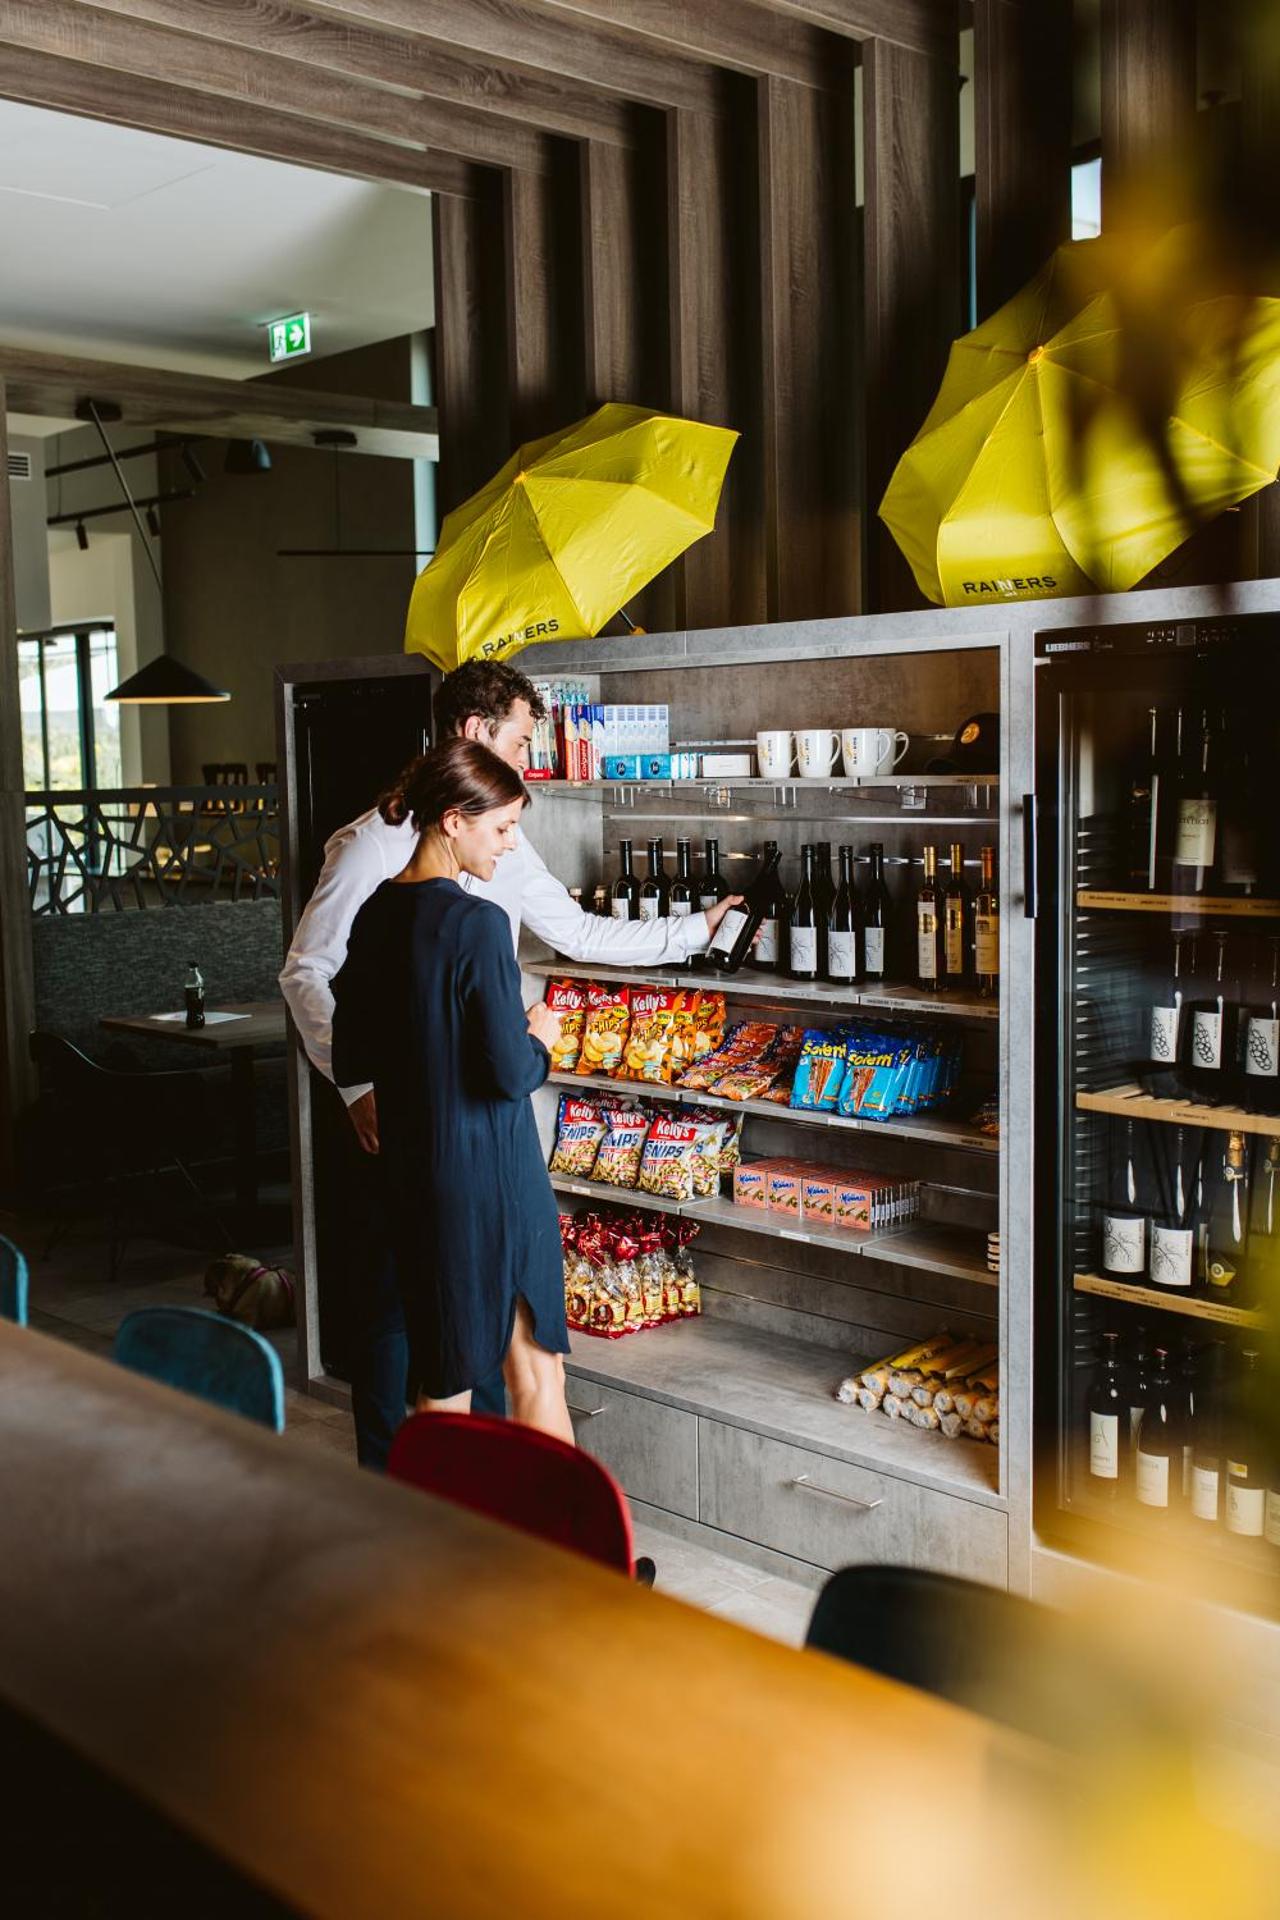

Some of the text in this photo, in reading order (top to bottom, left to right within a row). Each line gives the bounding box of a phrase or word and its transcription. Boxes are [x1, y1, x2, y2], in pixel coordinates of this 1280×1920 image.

[962, 577, 1057, 594] RAINERS
[632, 993, 667, 1011] Kelly's
[591, 1018, 620, 1034] CHIPS
[611, 1110, 641, 1127] Kelly's
[560, 1125, 598, 1140] SNIPS
[657, 1120, 690, 1139] Kelly's
[645, 1142, 686, 1158] SNIPS
